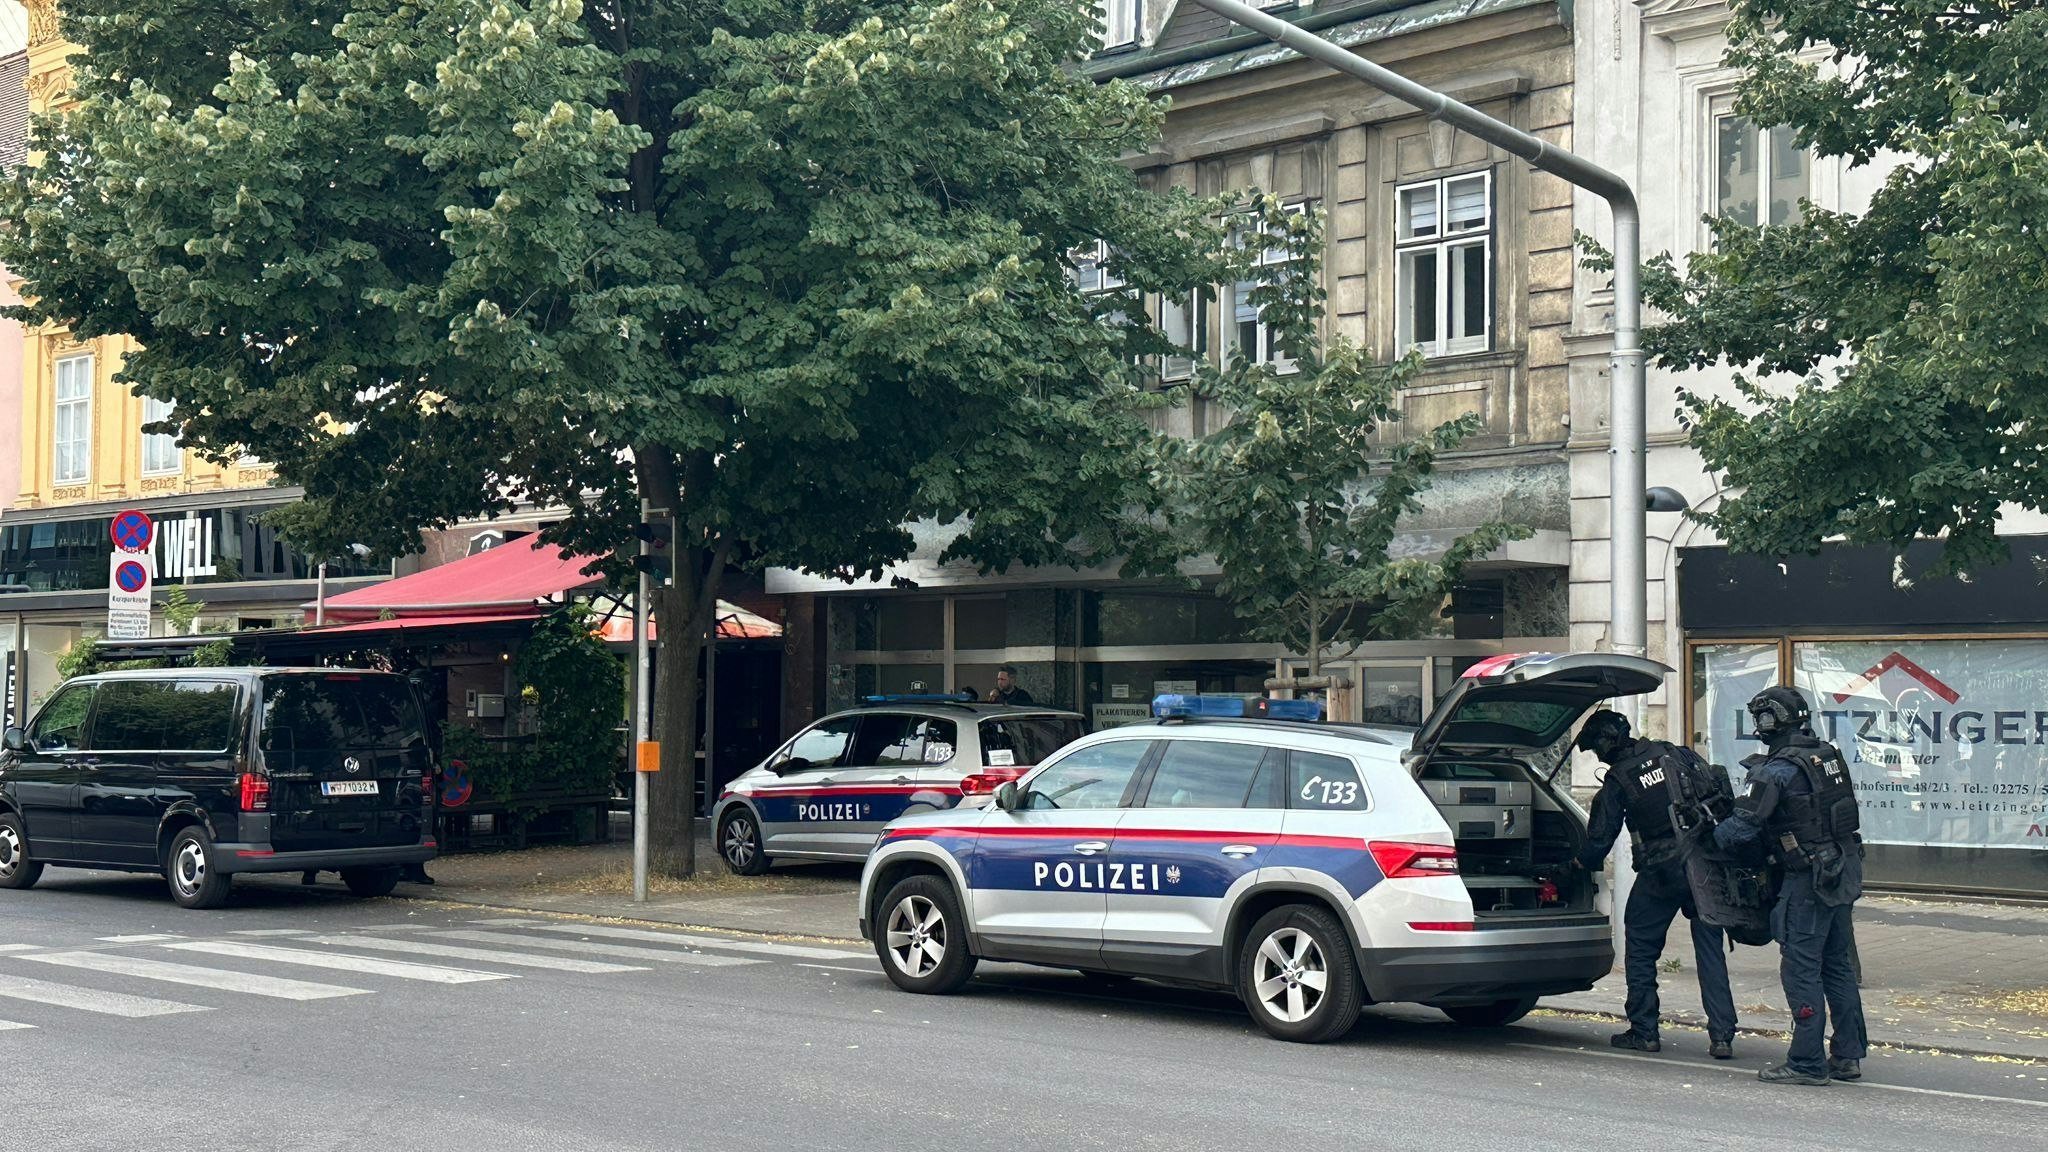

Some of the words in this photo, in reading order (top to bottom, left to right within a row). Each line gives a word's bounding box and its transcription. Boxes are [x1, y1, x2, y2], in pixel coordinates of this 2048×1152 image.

[164, 517, 217, 578] WELL
[934, 746, 953, 761] 133
[1321, 781, 1358, 804] 133
[1961, 783, 1988, 793] Tel.:
[1992, 784, 2029, 794] 02275
[799, 803, 860, 820] POLIZEI
[1034, 861, 1160, 890] POLIZEI
